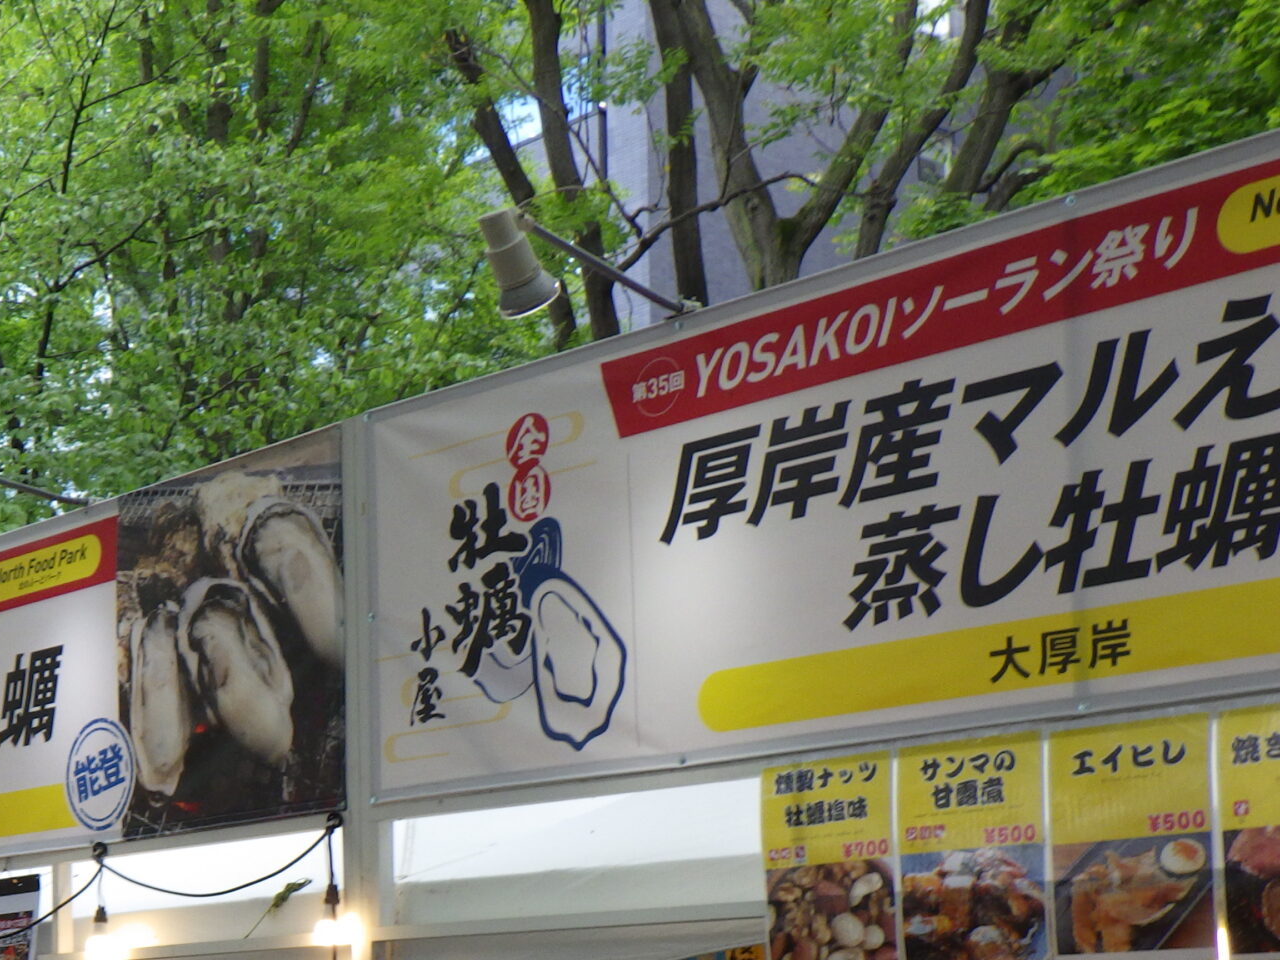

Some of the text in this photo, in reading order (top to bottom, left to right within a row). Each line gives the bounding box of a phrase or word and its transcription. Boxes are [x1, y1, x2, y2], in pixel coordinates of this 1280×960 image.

[1250, 187, 1280, 224] N
[631, 206, 1199, 404] 第35回 YOSAKOIソーラン祭り
[659, 291, 1280, 545] 厚岸産マルえ
[842, 432, 1280, 631] 蒸し牡蠣
[26, 555, 56, 578] Food
[57, 544, 88, 570] Park
[445, 482, 531, 677] 牡蠣
[989, 618, 1133, 684] 大厚岸
[73, 741, 126, 800] 能登
[920, 749, 1016, 782] サンマの
[931, 776, 1005, 810] 甘露煮
[784, 795, 868, 828] 牡蠣塩味
[1147, 808, 1206, 833] ¥500
[841, 838, 889, 860] ¥700
[982, 823, 1037, 845] ¥500
